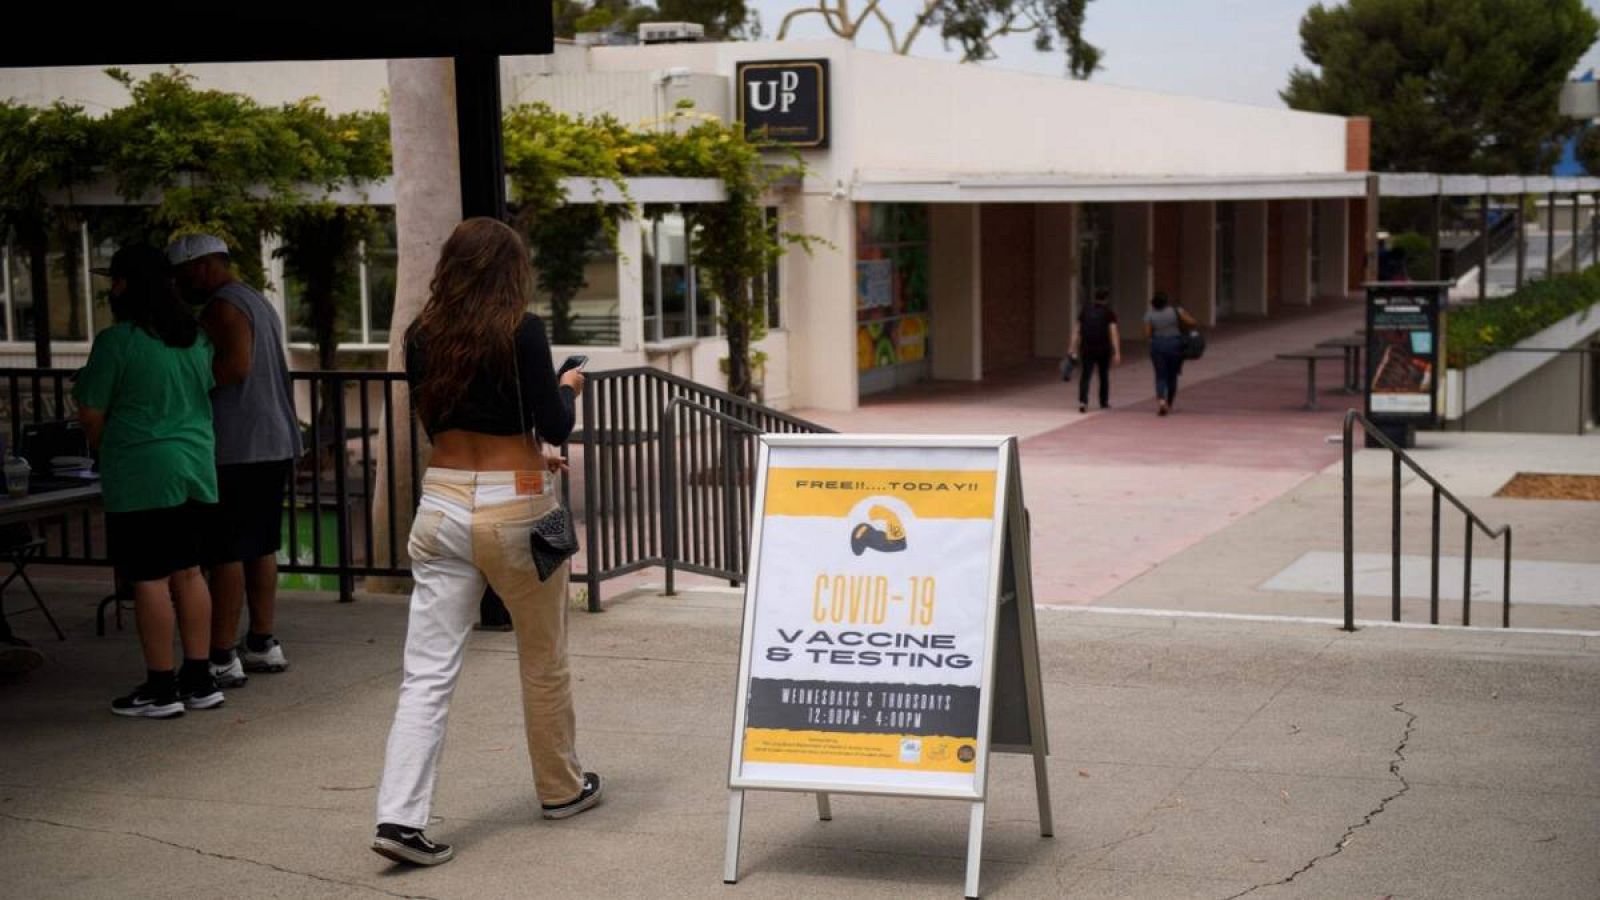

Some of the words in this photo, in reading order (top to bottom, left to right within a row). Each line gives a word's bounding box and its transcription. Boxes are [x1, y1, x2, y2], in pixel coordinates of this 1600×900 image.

[813, 574, 936, 626] COVID-19
[778, 628, 956, 649] VACCINE
[766, 647, 793, 662] &
[806, 648, 973, 669] TESTING
[782, 688, 860, 707] WEDNESDAYS
[882, 692, 952, 711] THURSDAYS
[876, 710, 922, 728] 4:00PM
